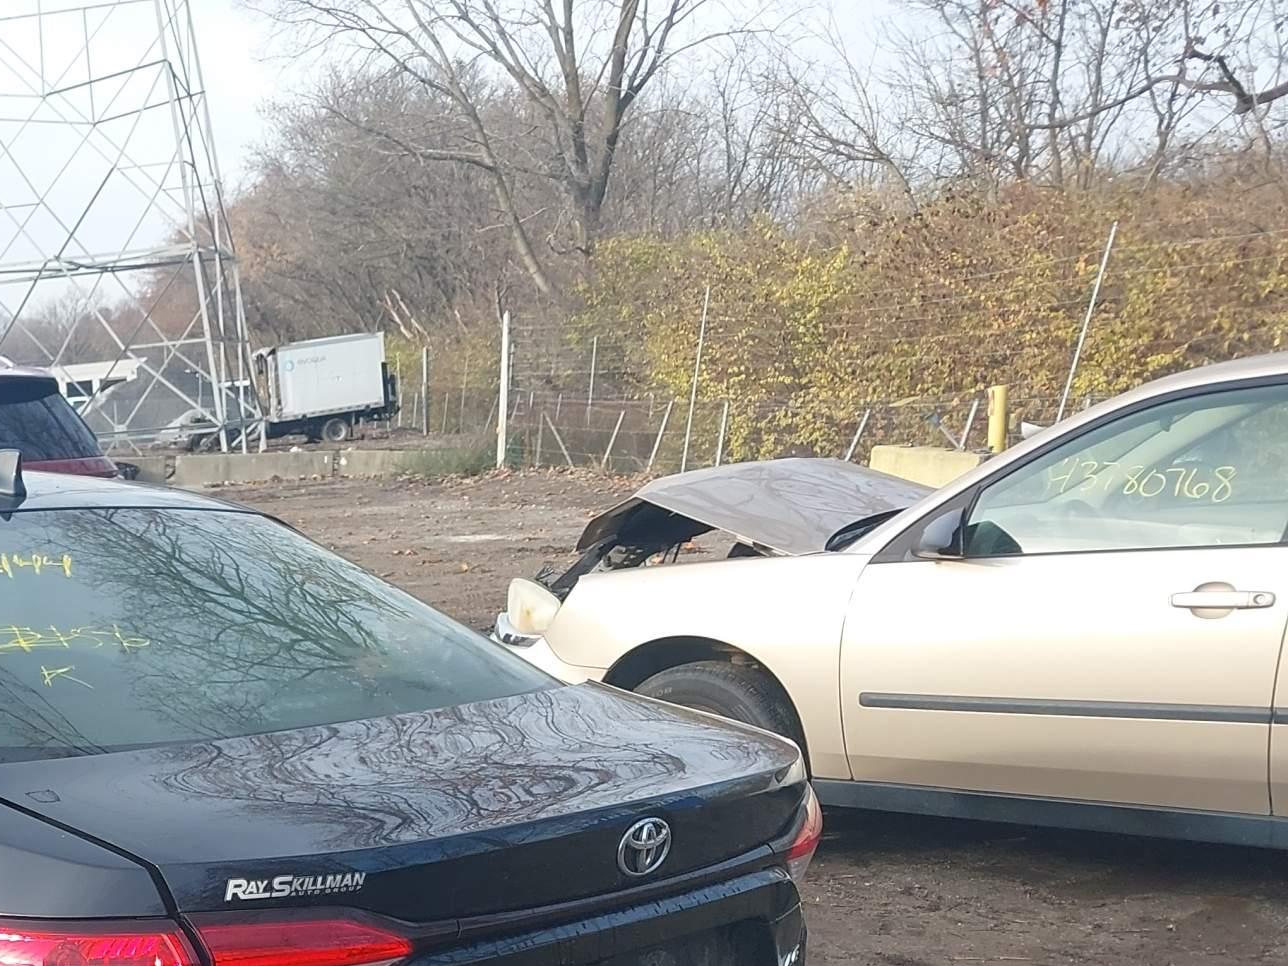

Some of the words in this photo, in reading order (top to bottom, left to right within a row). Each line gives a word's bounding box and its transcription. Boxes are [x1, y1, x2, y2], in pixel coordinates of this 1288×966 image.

[1046, 457, 1237, 503] 43780768
[224, 878, 270, 901] RAY
[271, 871, 366, 898] SKILLMAN
[290, 889, 321, 897] AUTO
[325, 885, 362, 895] GROUP
